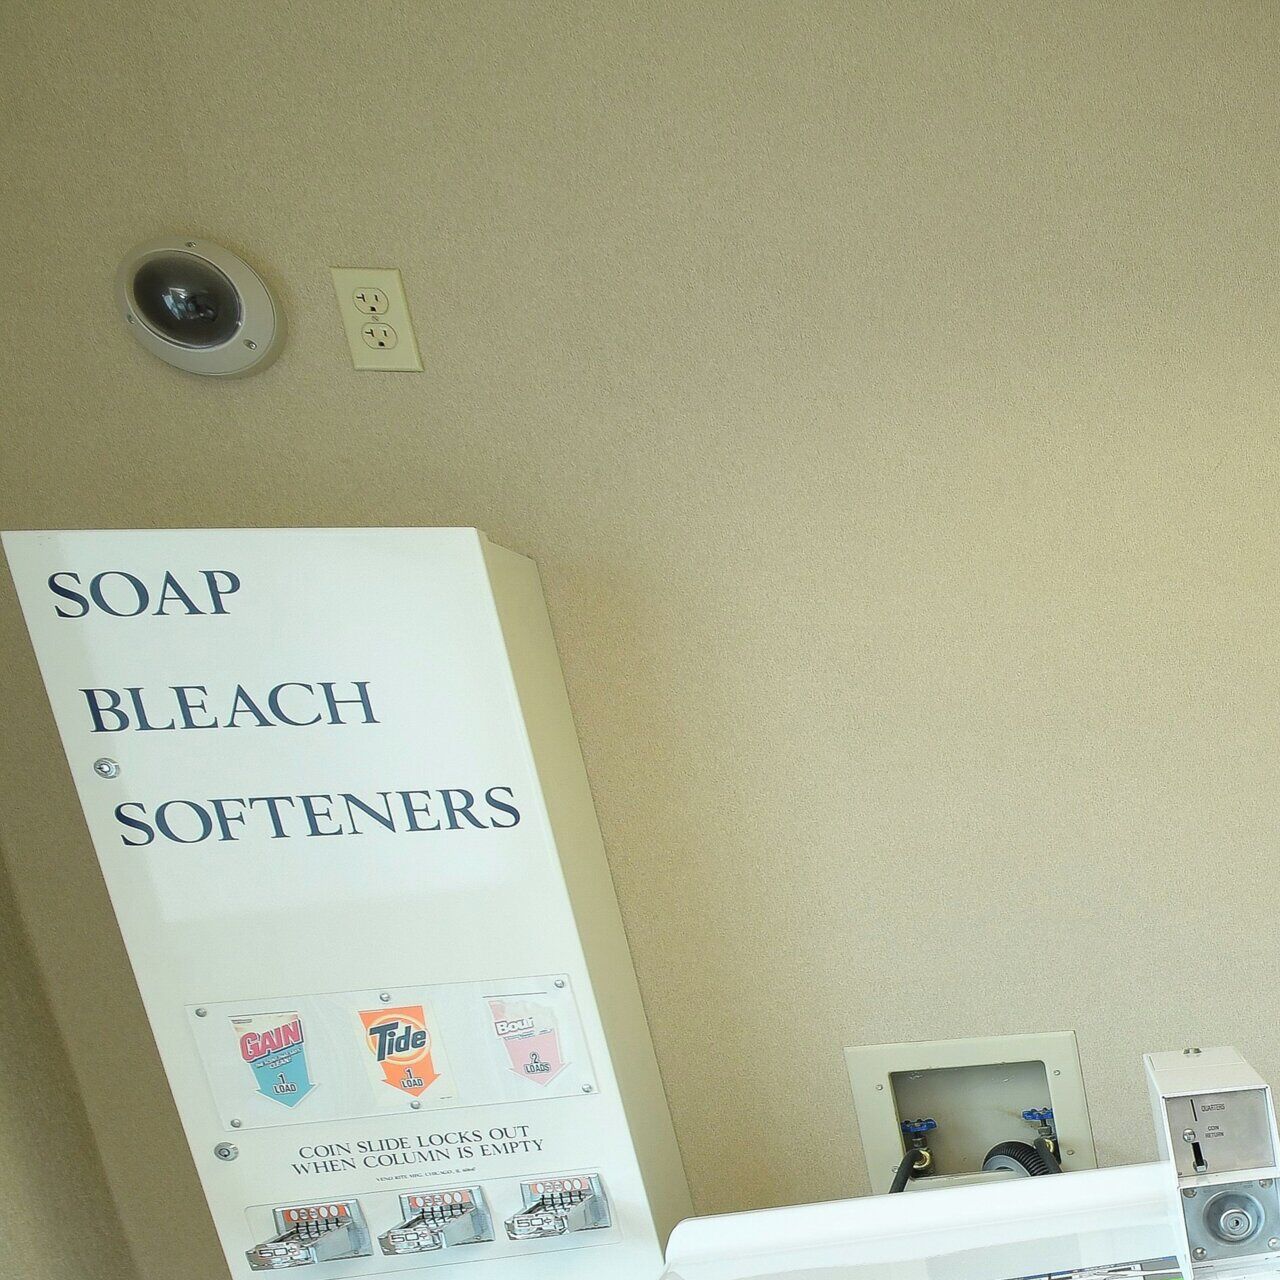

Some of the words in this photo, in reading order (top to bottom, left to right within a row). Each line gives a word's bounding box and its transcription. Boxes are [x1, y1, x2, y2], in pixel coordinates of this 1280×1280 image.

[47, 569, 241, 618] SOAP
[79, 681, 380, 733] BLEACH
[114, 786, 521, 847] SOFTENERS
[240, 1018, 304, 1063] GAIN
[369, 1021, 427, 1061] Tide
[405, 1068, 413, 1079] 1
[525, 1063, 550, 1073] LOADS
[531, 1053, 539, 1064] 2
[273, 1083, 297, 1094] LOAD
[278, 1072, 286, 1084] 1
[401, 1078, 424, 1088] LOAD
[291, 1157, 357, 1175] WHEN
[363, 1148, 451, 1168] COLUMN
[457, 1146, 474, 1159] IS
[480, 1139, 543, 1156] EMPTY
[299, 1142, 352, 1159] COIN
[357, 1137, 411, 1154] SLIDE
[416, 1130, 483, 1147] LOCKS
[489, 1125, 529, 1140] OUT
